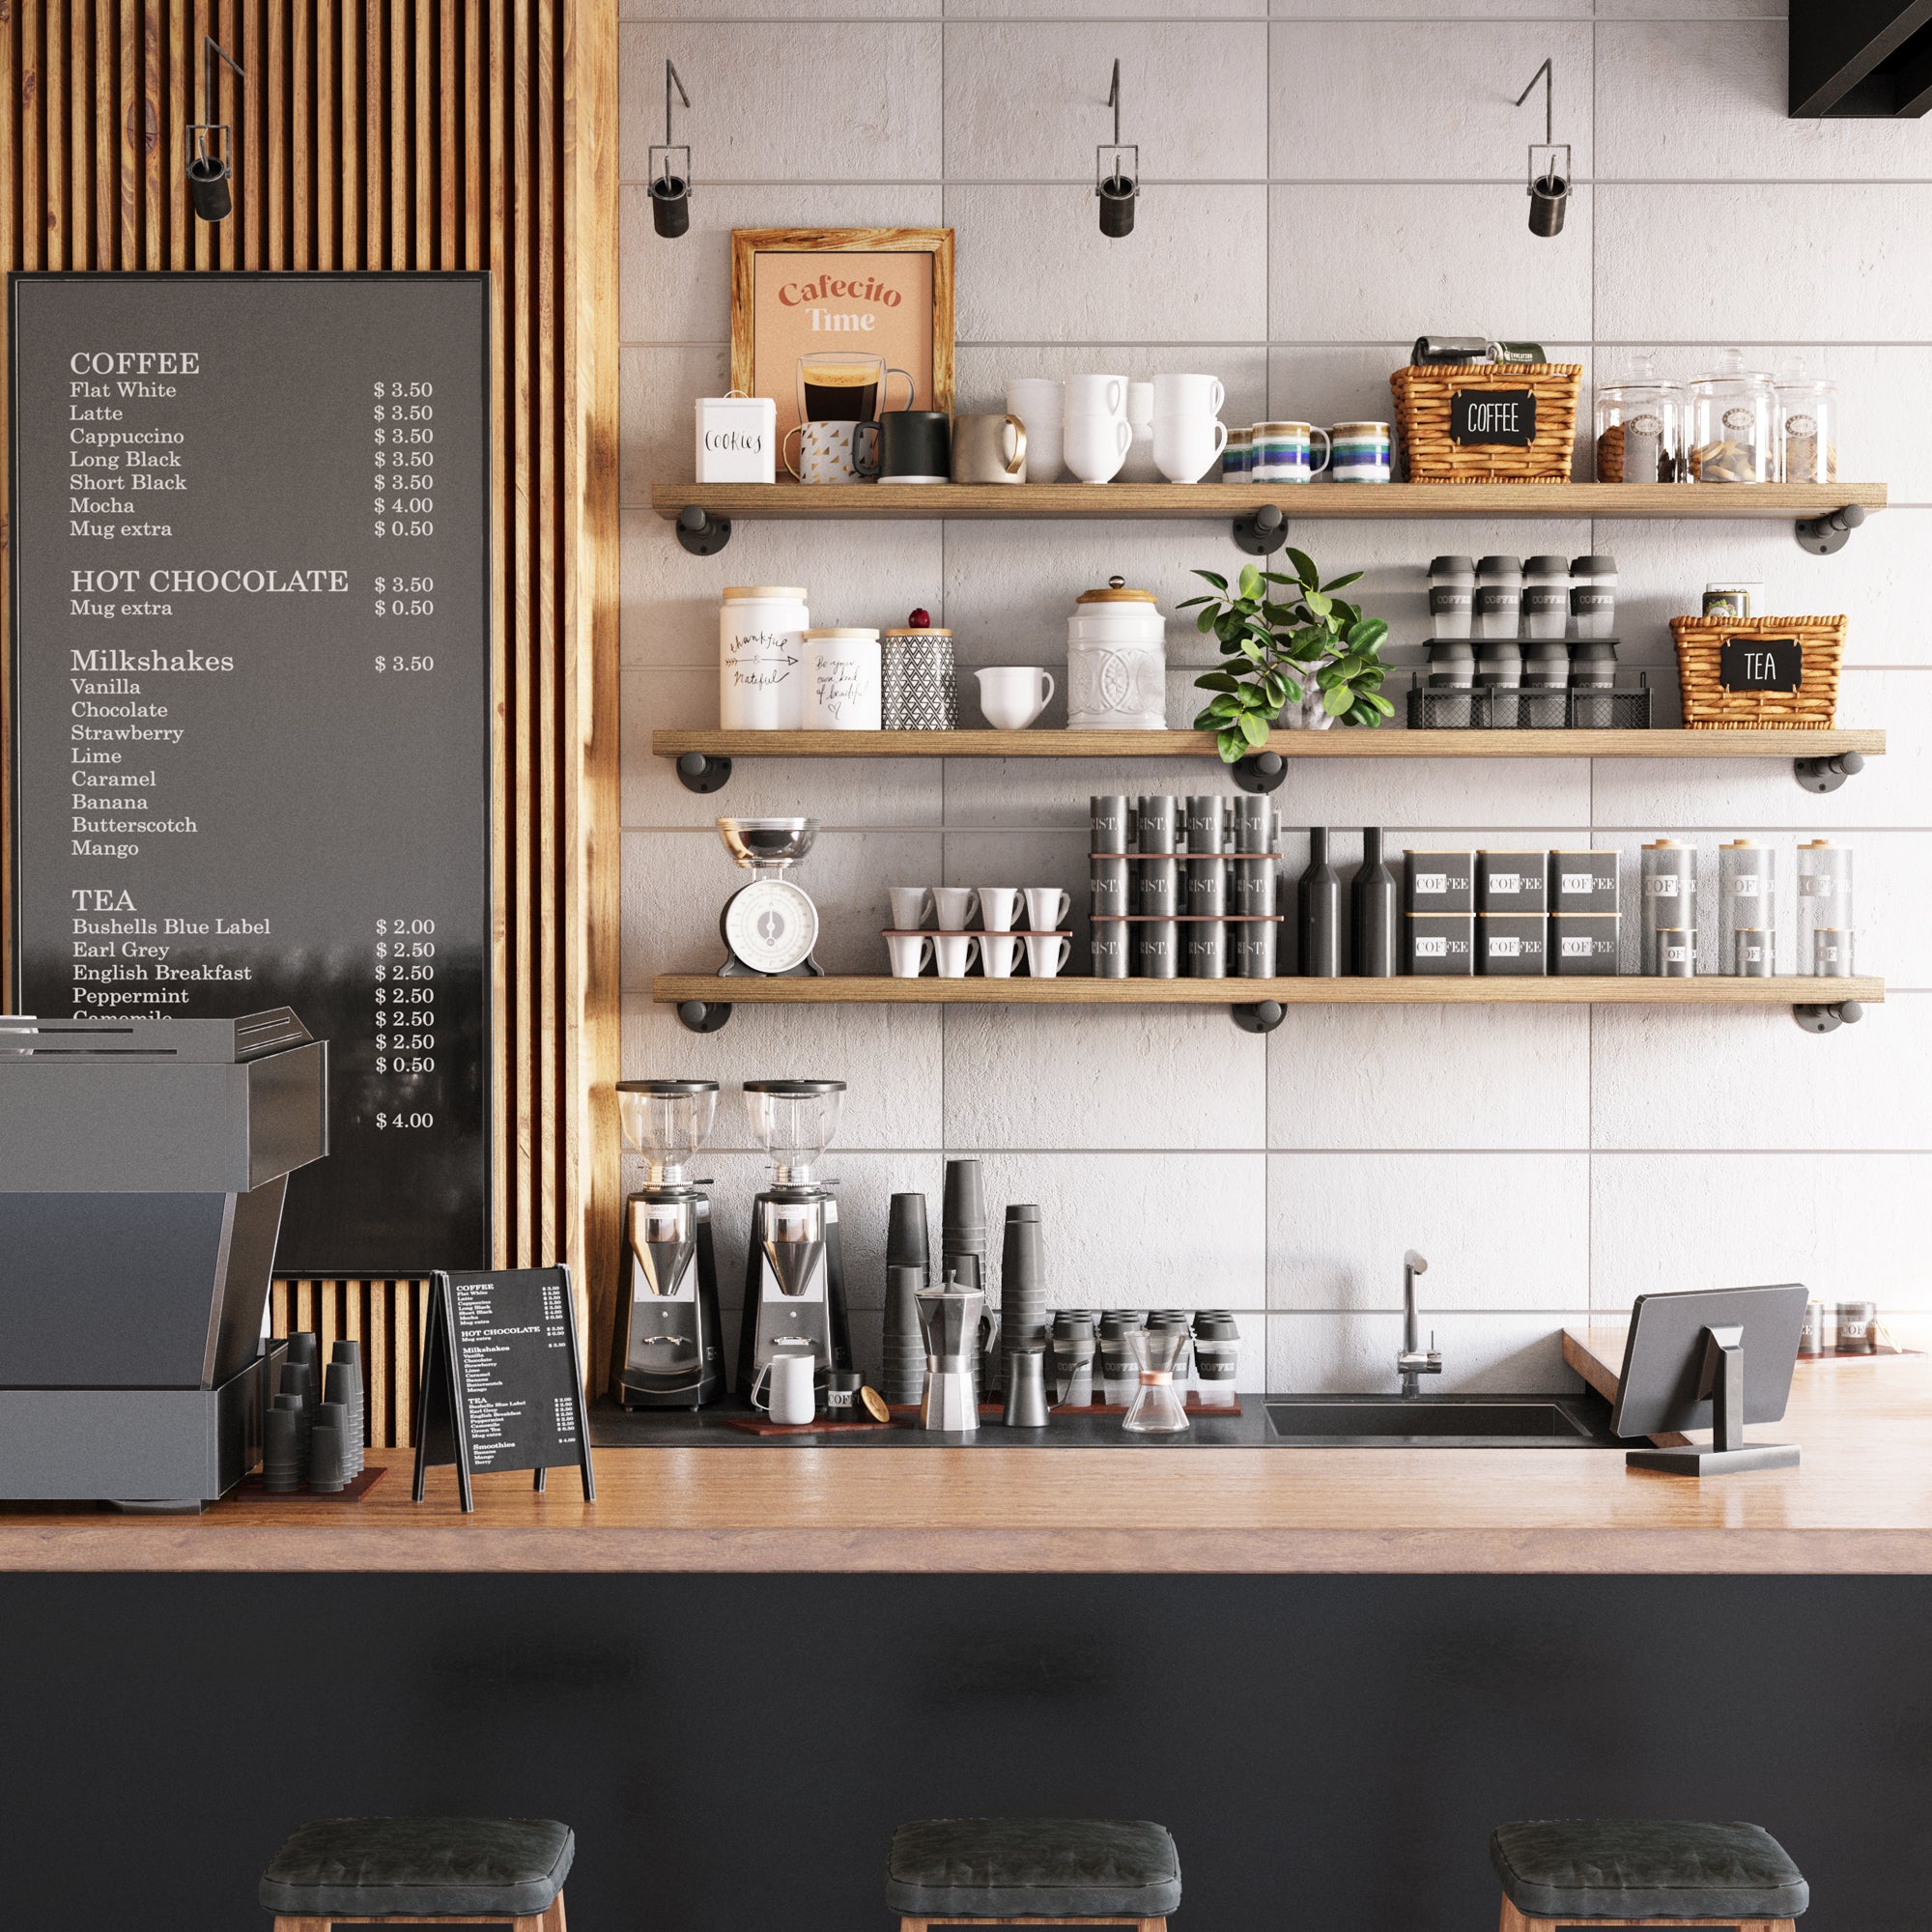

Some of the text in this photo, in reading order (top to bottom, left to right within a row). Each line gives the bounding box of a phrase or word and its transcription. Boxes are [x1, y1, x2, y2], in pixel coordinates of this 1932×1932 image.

[778, 274, 902, 307] Cafecito
[805, 308, 876, 332] Time
[71, 353, 199, 375] COFFEE
[70, 382, 110, 397] Flat
[117, 382, 176, 397] White
[70, 405, 123, 420] Latte
[1467, 403, 1520, 433] COFFEE
[71, 428, 184, 447] Cappuccino
[705, 430, 761, 454] Cookies
[71, 451, 119, 470] Long
[127, 451, 182, 467] Black
[71, 474, 125, 490] Short
[131, 474, 187, 490] Black
[70, 497, 134, 513] Mocha
[70, 521, 115, 539] Mug
[121, 523, 172, 536] extra
[71, 570, 140, 592] HOT
[150, 570, 349, 592] CHOCOLATE
[71, 600, 115, 618] Mug
[122, 602, 173, 615] extra
[71, 649, 234, 671] Milkshakes
[1744, 652, 1776, 680] TEA
[71, 678, 141, 694] Vanilla
[71, 701, 167, 717] Chocolate
[71, 724, 184, 744] Strawberry
[71, 748, 122, 763] Lime
[71, 771, 156, 786] Caramel
[72, 794, 148, 810] Banana
[72, 816, 197, 832] Butterscotch
[71, 839, 139, 859] Mango
[1416, 877, 1469, 890] COFFEE
[1490, 877, 1543, 890] COFFEE
[1562, 877, 1615, 890] COFFEE
[72, 890, 137, 911] TEA
[72, 919, 157, 934] Bushells
[164, 919, 209, 934] Blue
[215, 919, 270, 934] Label
[73, 942, 115, 956] Earl
[122, 942, 169, 960] Grey
[1416, 941, 1469, 953] COFFEE
[1490, 941, 1543, 953] COFFEE
[1562, 941, 1615, 953] COFFEE
[73, 965, 148, 983] English
[156, 965, 252, 980] Breakfast
[72, 987, 189, 1007] Peppermint
[483, 1326, 540, 1335] CHOCOLATE
[473, 1442, 516, 1451] Smoothies
